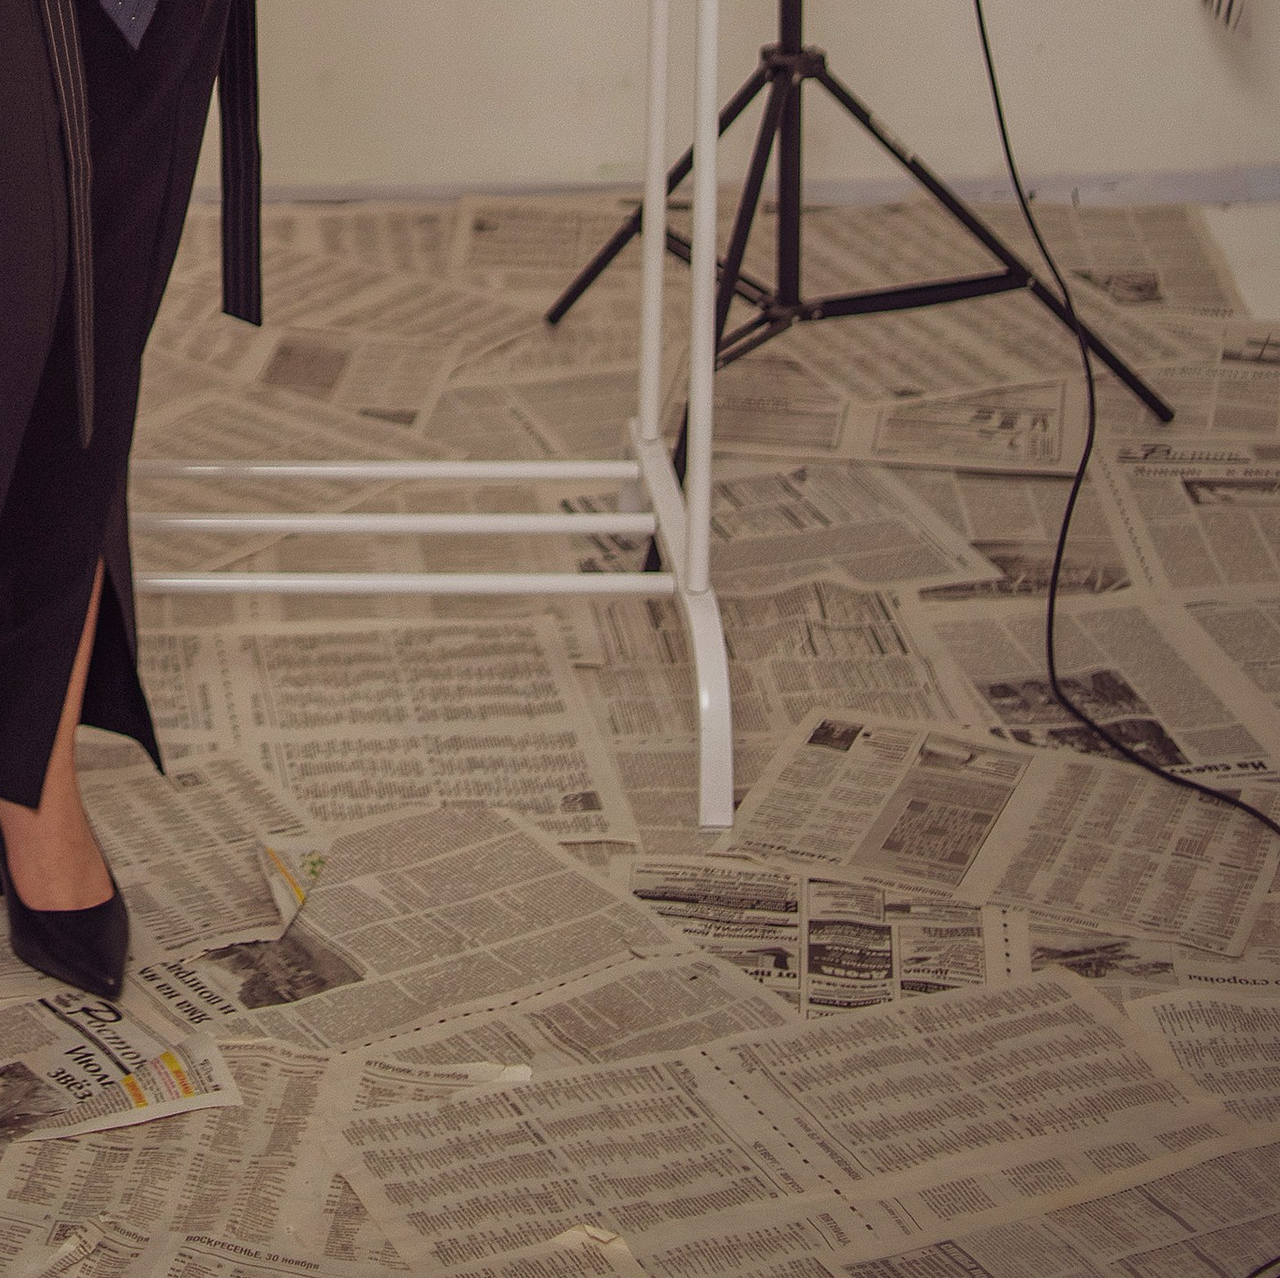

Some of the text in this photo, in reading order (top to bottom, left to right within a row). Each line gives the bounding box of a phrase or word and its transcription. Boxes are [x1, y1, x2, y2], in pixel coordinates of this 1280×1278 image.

[1187, 974, 1269, 985] стороны
[174, 999, 213, 1027] Яма
[45, 1065, 94, 1104] звёз
[264, 1251, 280, 1263] 30
[280, 1254, 320, 1272] ноября
